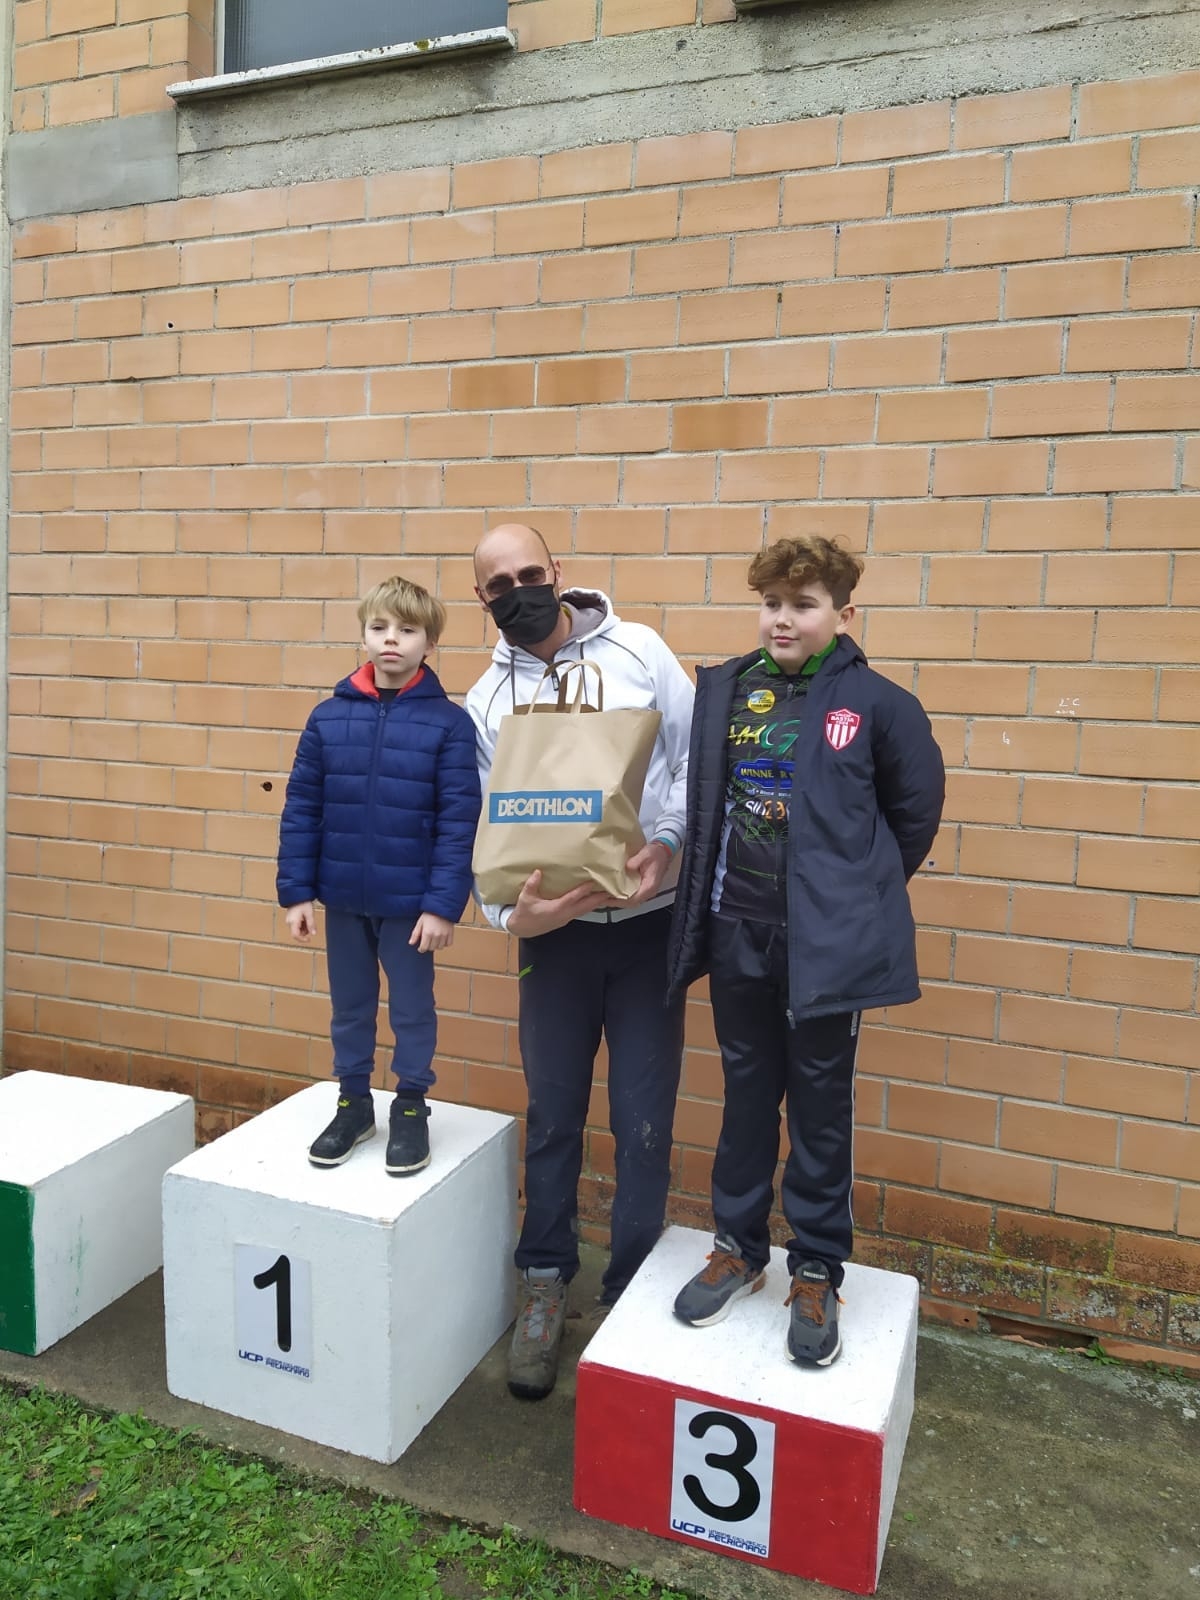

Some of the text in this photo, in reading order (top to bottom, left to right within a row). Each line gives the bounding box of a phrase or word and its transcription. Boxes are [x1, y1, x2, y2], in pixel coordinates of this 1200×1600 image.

[497, 797, 593, 817] DECATHLON
[253, 1254, 292, 1353] 1
[238, 1349, 264, 1363] UCP
[683, 1411, 760, 1522] 3
[672, 1518, 706, 1535] UCP
[708, 1533, 768, 1556] PETRIGNANO
